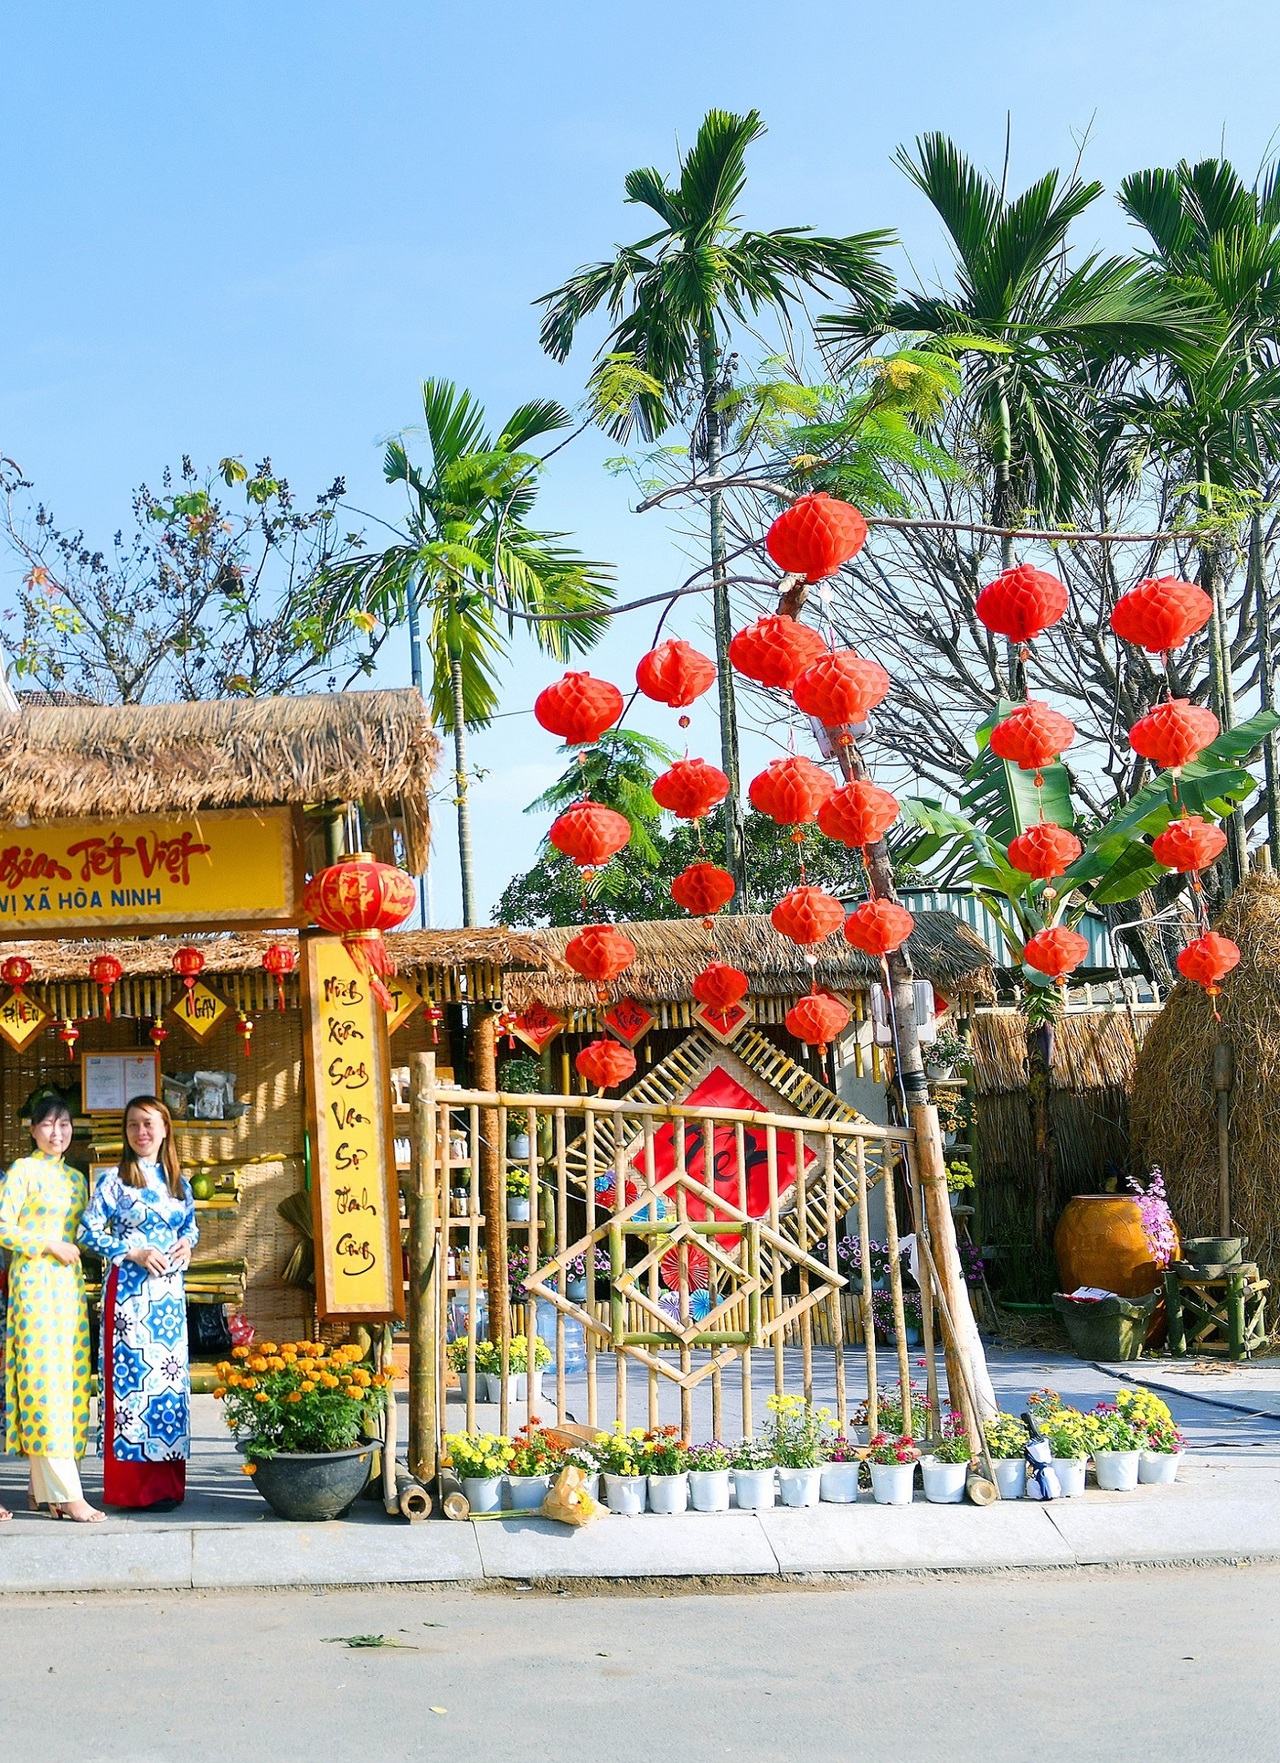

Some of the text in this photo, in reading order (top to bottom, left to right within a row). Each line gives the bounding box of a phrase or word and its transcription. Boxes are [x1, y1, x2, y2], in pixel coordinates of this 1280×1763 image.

[66, 831, 136, 886] Tết
[135, 829, 211, 886] Việt
[22, 886, 52, 912] XÃ
[58, 887, 103, 910] HÒA
[110, 887, 161, 907] NINH
